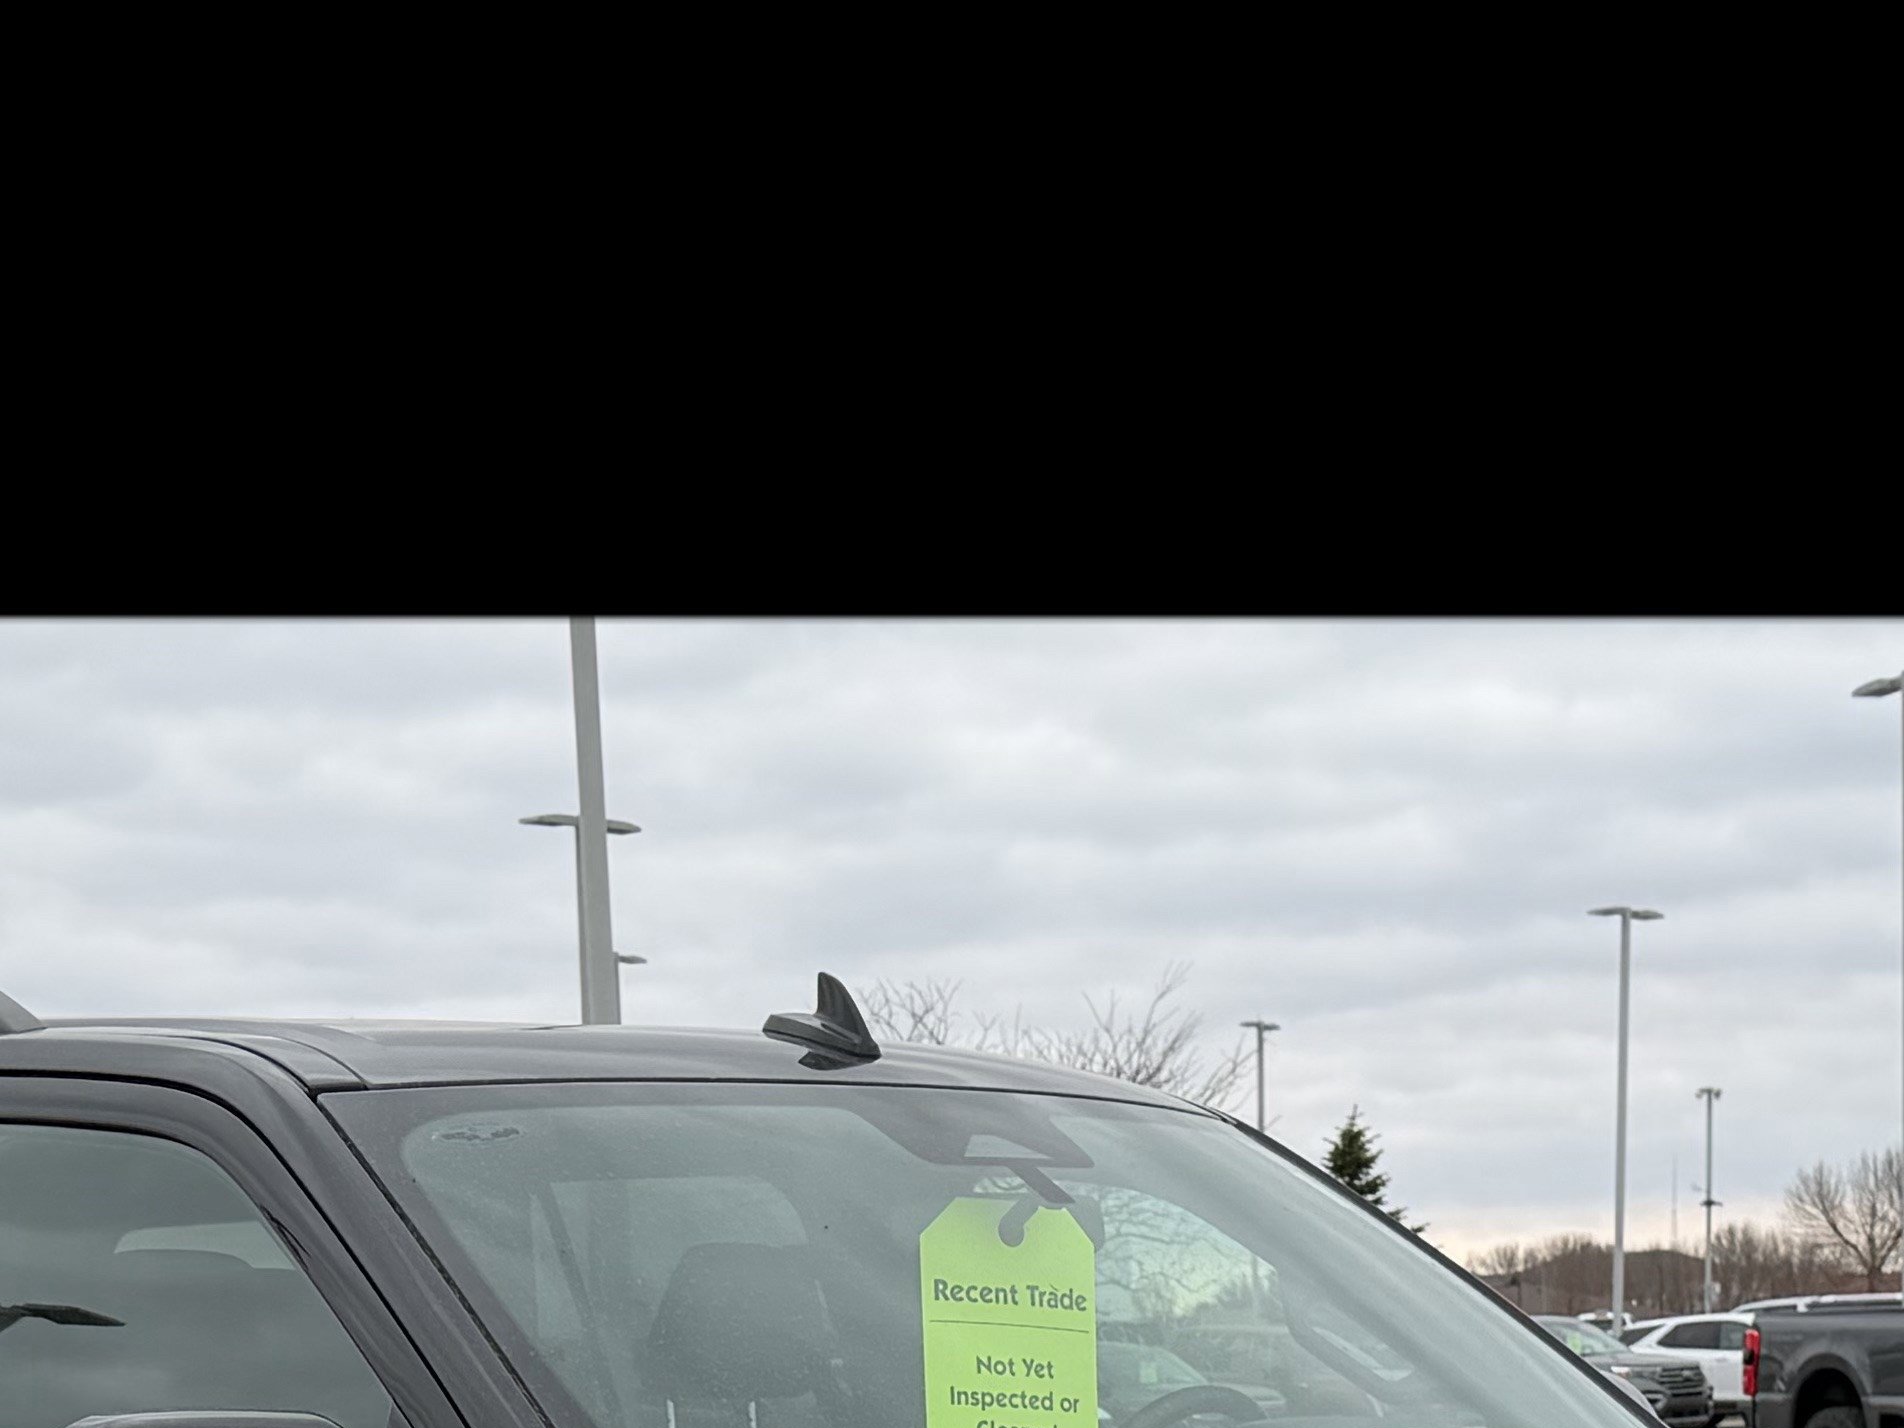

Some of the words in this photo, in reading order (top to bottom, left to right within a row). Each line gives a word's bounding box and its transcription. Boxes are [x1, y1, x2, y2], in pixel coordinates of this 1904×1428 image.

[933, 1278, 1019, 1306] Recent
[1026, 1284, 1087, 1312] Trade
[975, 1355, 1016, 1377] Not
[1021, 1357, 1055, 1380] Yet
[949, 1385, 1054, 1412] Inspected
[1060, 1397, 1080, 1414] or
